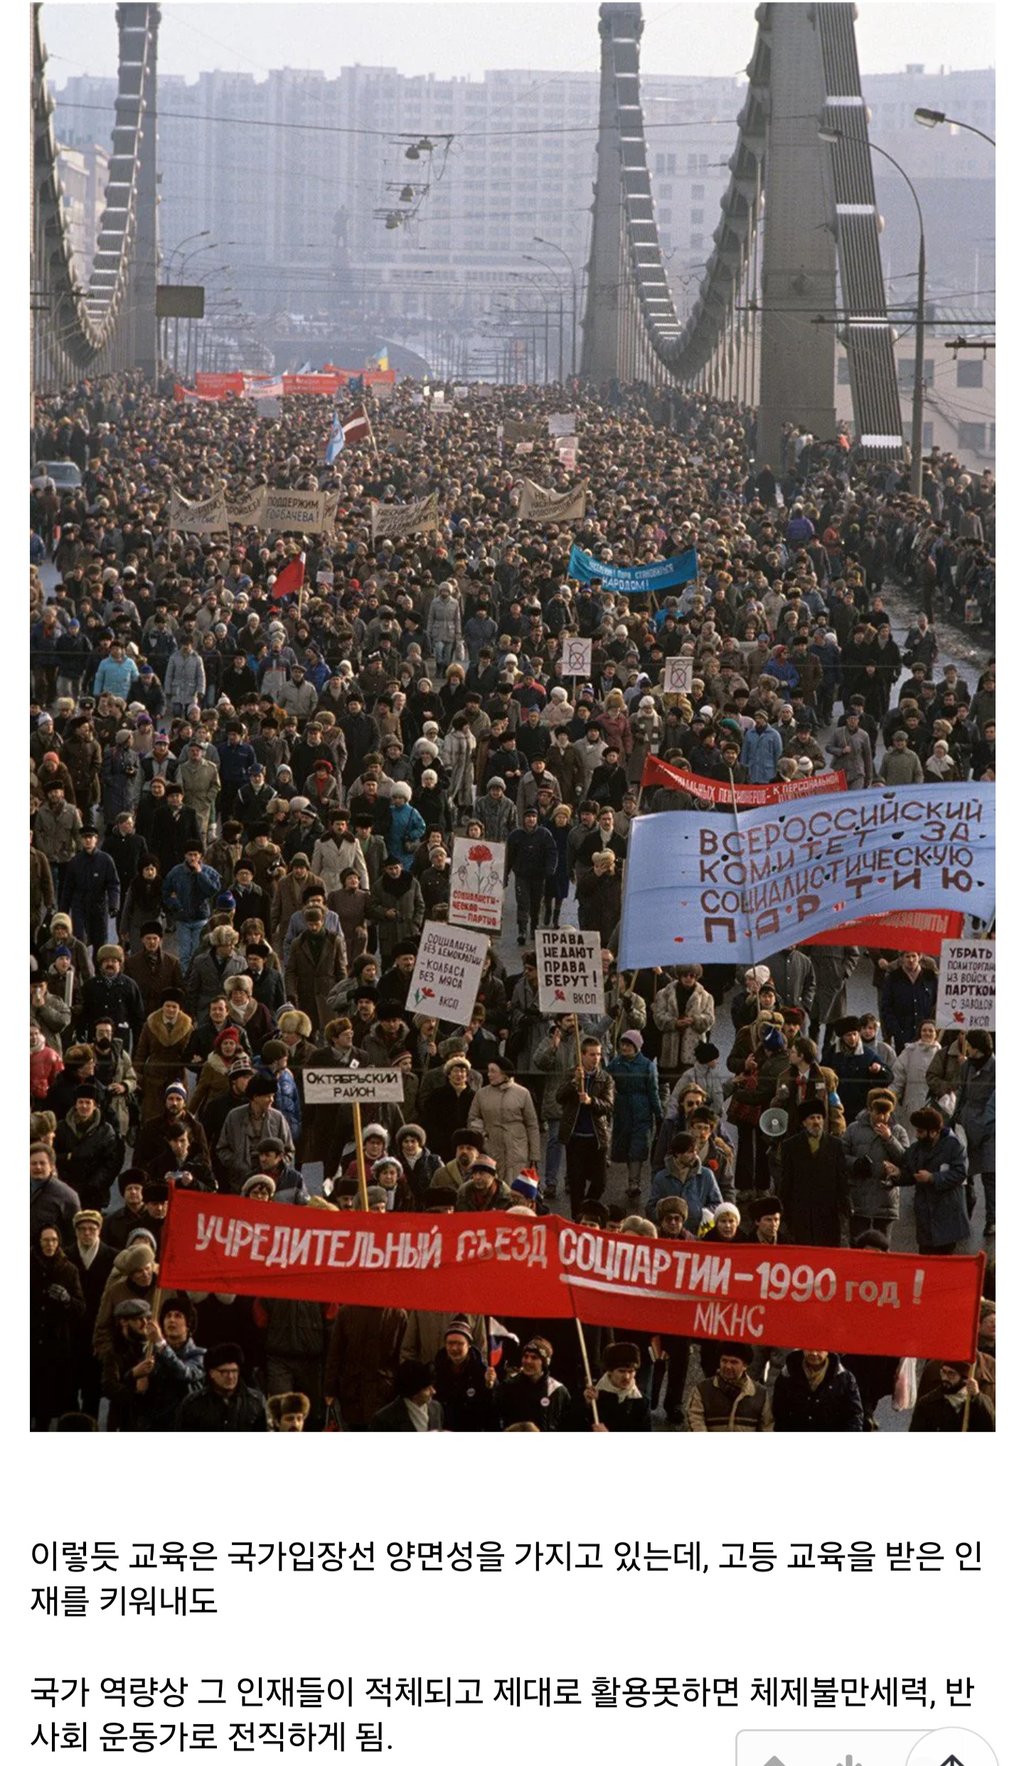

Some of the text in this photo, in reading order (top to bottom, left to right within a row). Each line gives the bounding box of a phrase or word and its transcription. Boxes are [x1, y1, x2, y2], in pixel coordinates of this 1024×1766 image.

[700, 799, 983, 857] ВСЕРОССИЙСКИЙ
[700, 821, 970, 885] КОМИТЕТ ЗА
[700, 845, 974, 914] СОЦИАЛИСТИЧЕСКУЮ
[427, 933, 478, 954] СОЦИАЛИЗМ
[542, 933, 584, 945] ПРАВА
[423, 942, 436, 954] БЕЗ
[949, 947, 993, 959] УБРАТЬ
[544, 961, 586, 973] ПРАВА
[419, 969, 463, 989] БЕЗ МЯСА
[947, 972, 958, 983] ИЗ
[573, 993, 597, 1005] ВКСП
[306, 1072, 398, 1085] ОКТЯБРЬСКИЙ
[333, 1085, 376, 1097] РАЙОН
[195, 1213, 443, 1269] УЧРЕДИТЕЛЬНЫЙ
[456, 1225, 548, 1269] СЪЕЗД
[845, 1281, 901, 1308] год
[693, 1302, 765, 1337] МКНС
